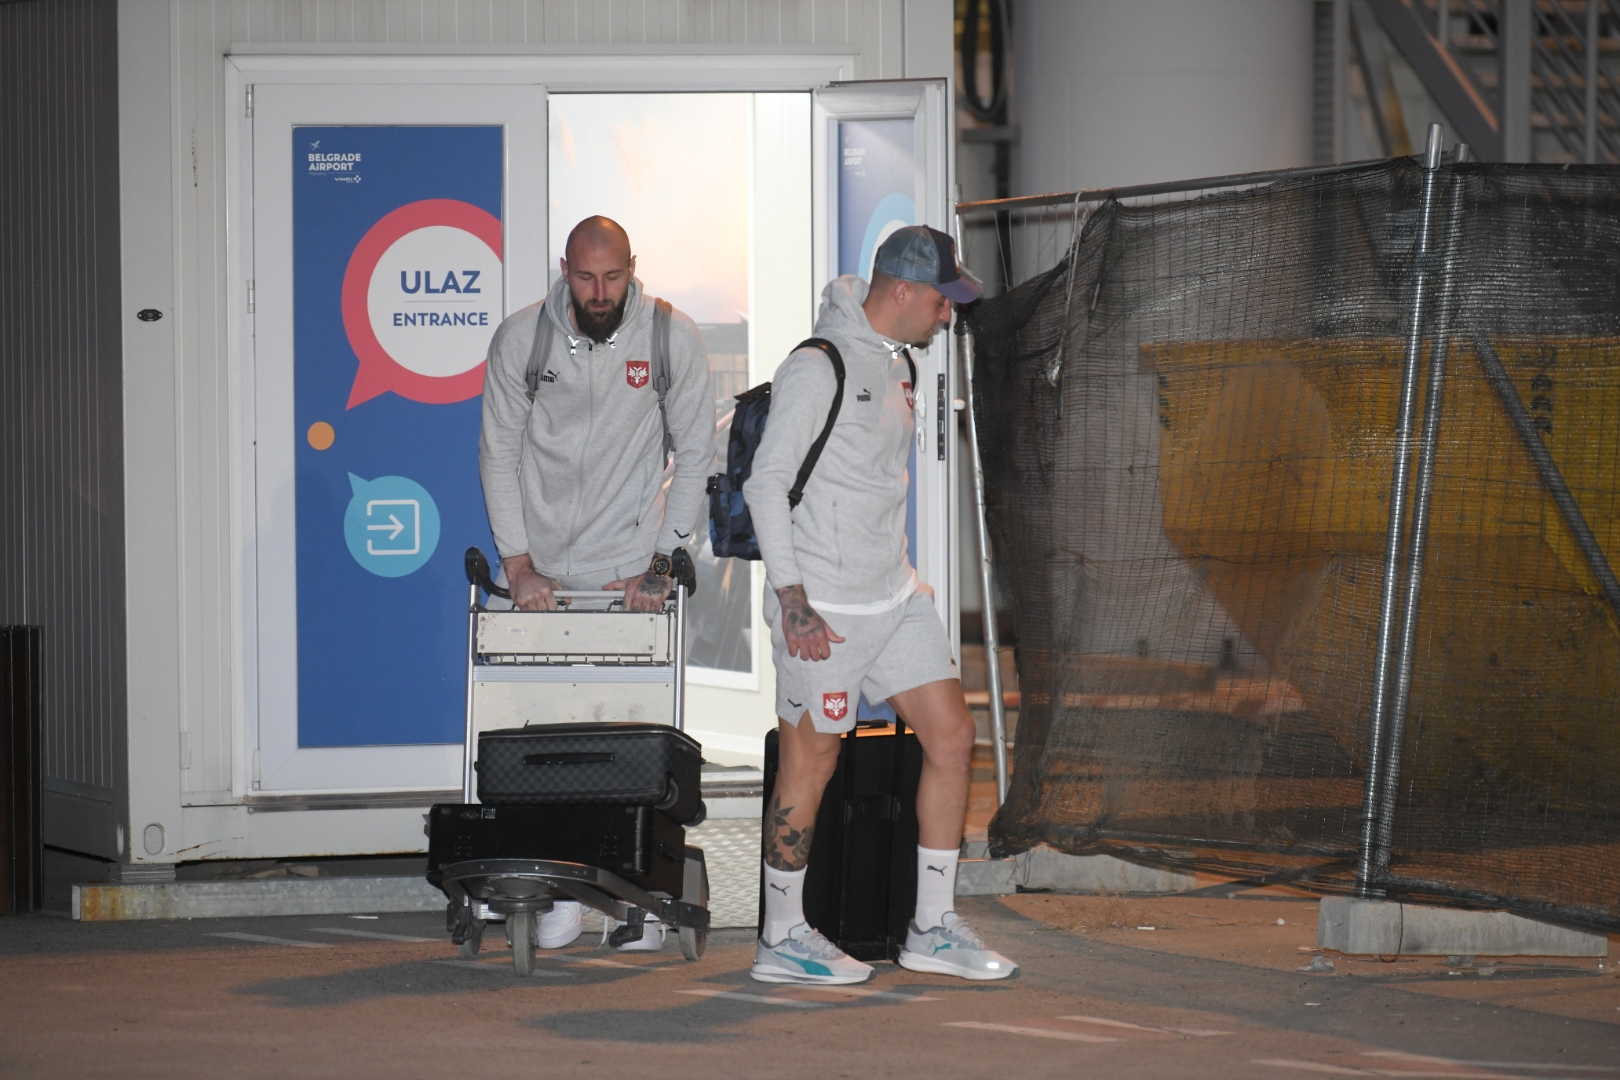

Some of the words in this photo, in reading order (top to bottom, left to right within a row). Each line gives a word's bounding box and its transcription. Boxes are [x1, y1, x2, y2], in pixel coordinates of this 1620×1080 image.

[308, 153, 361, 162] BELGRADE
[401, 270, 481, 294] ULAZ
[393, 312, 489, 326] ENTRANCE
[856, 394, 871, 402] PUMA
